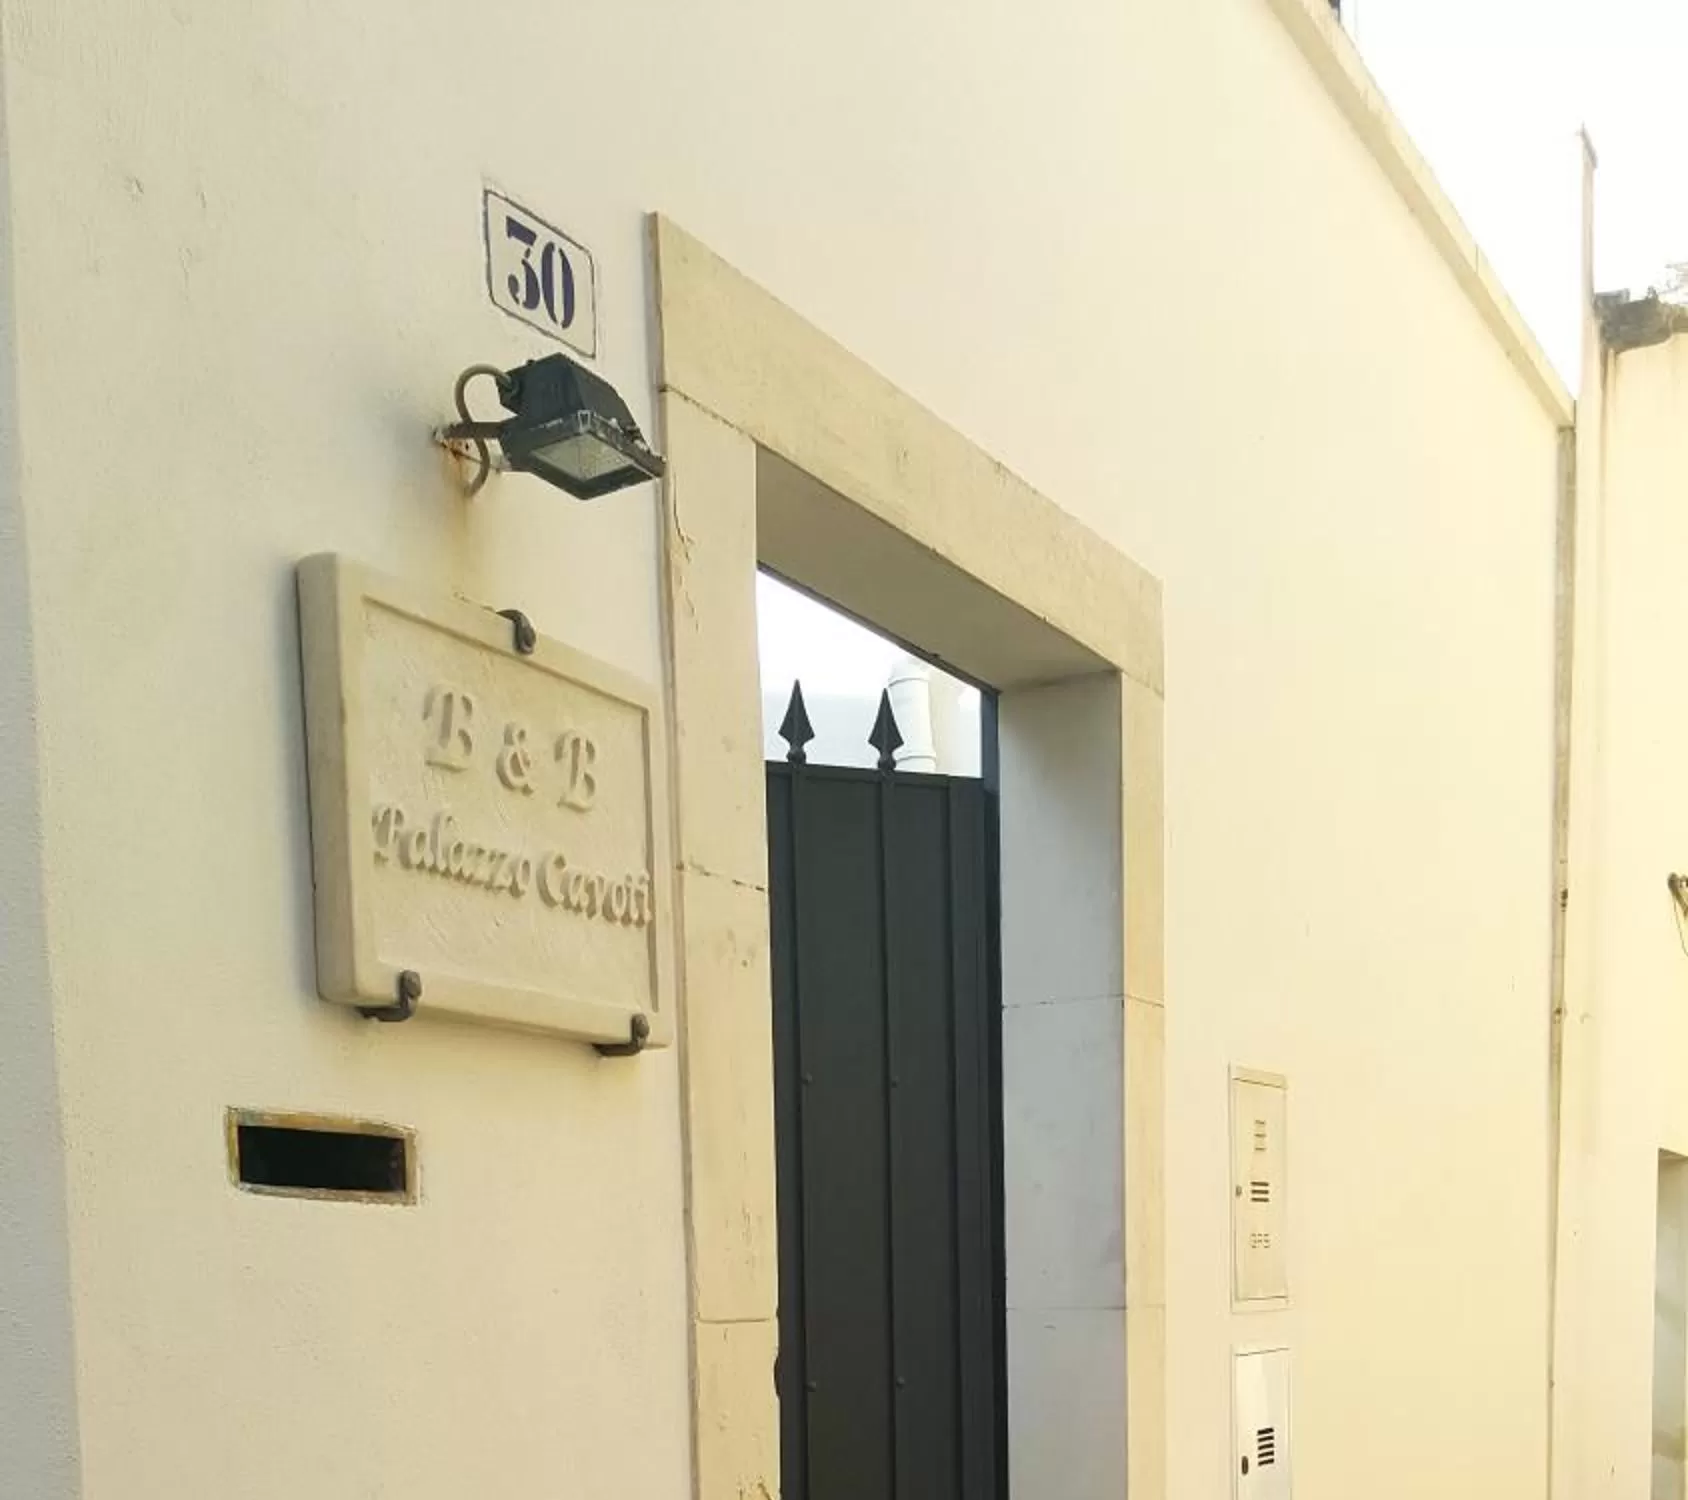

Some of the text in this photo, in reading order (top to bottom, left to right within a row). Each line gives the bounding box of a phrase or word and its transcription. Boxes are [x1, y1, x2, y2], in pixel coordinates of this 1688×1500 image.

[506, 215, 575, 329] 30
[422, 685, 598, 813] B & B
[370, 802, 533, 899] Palazzo
